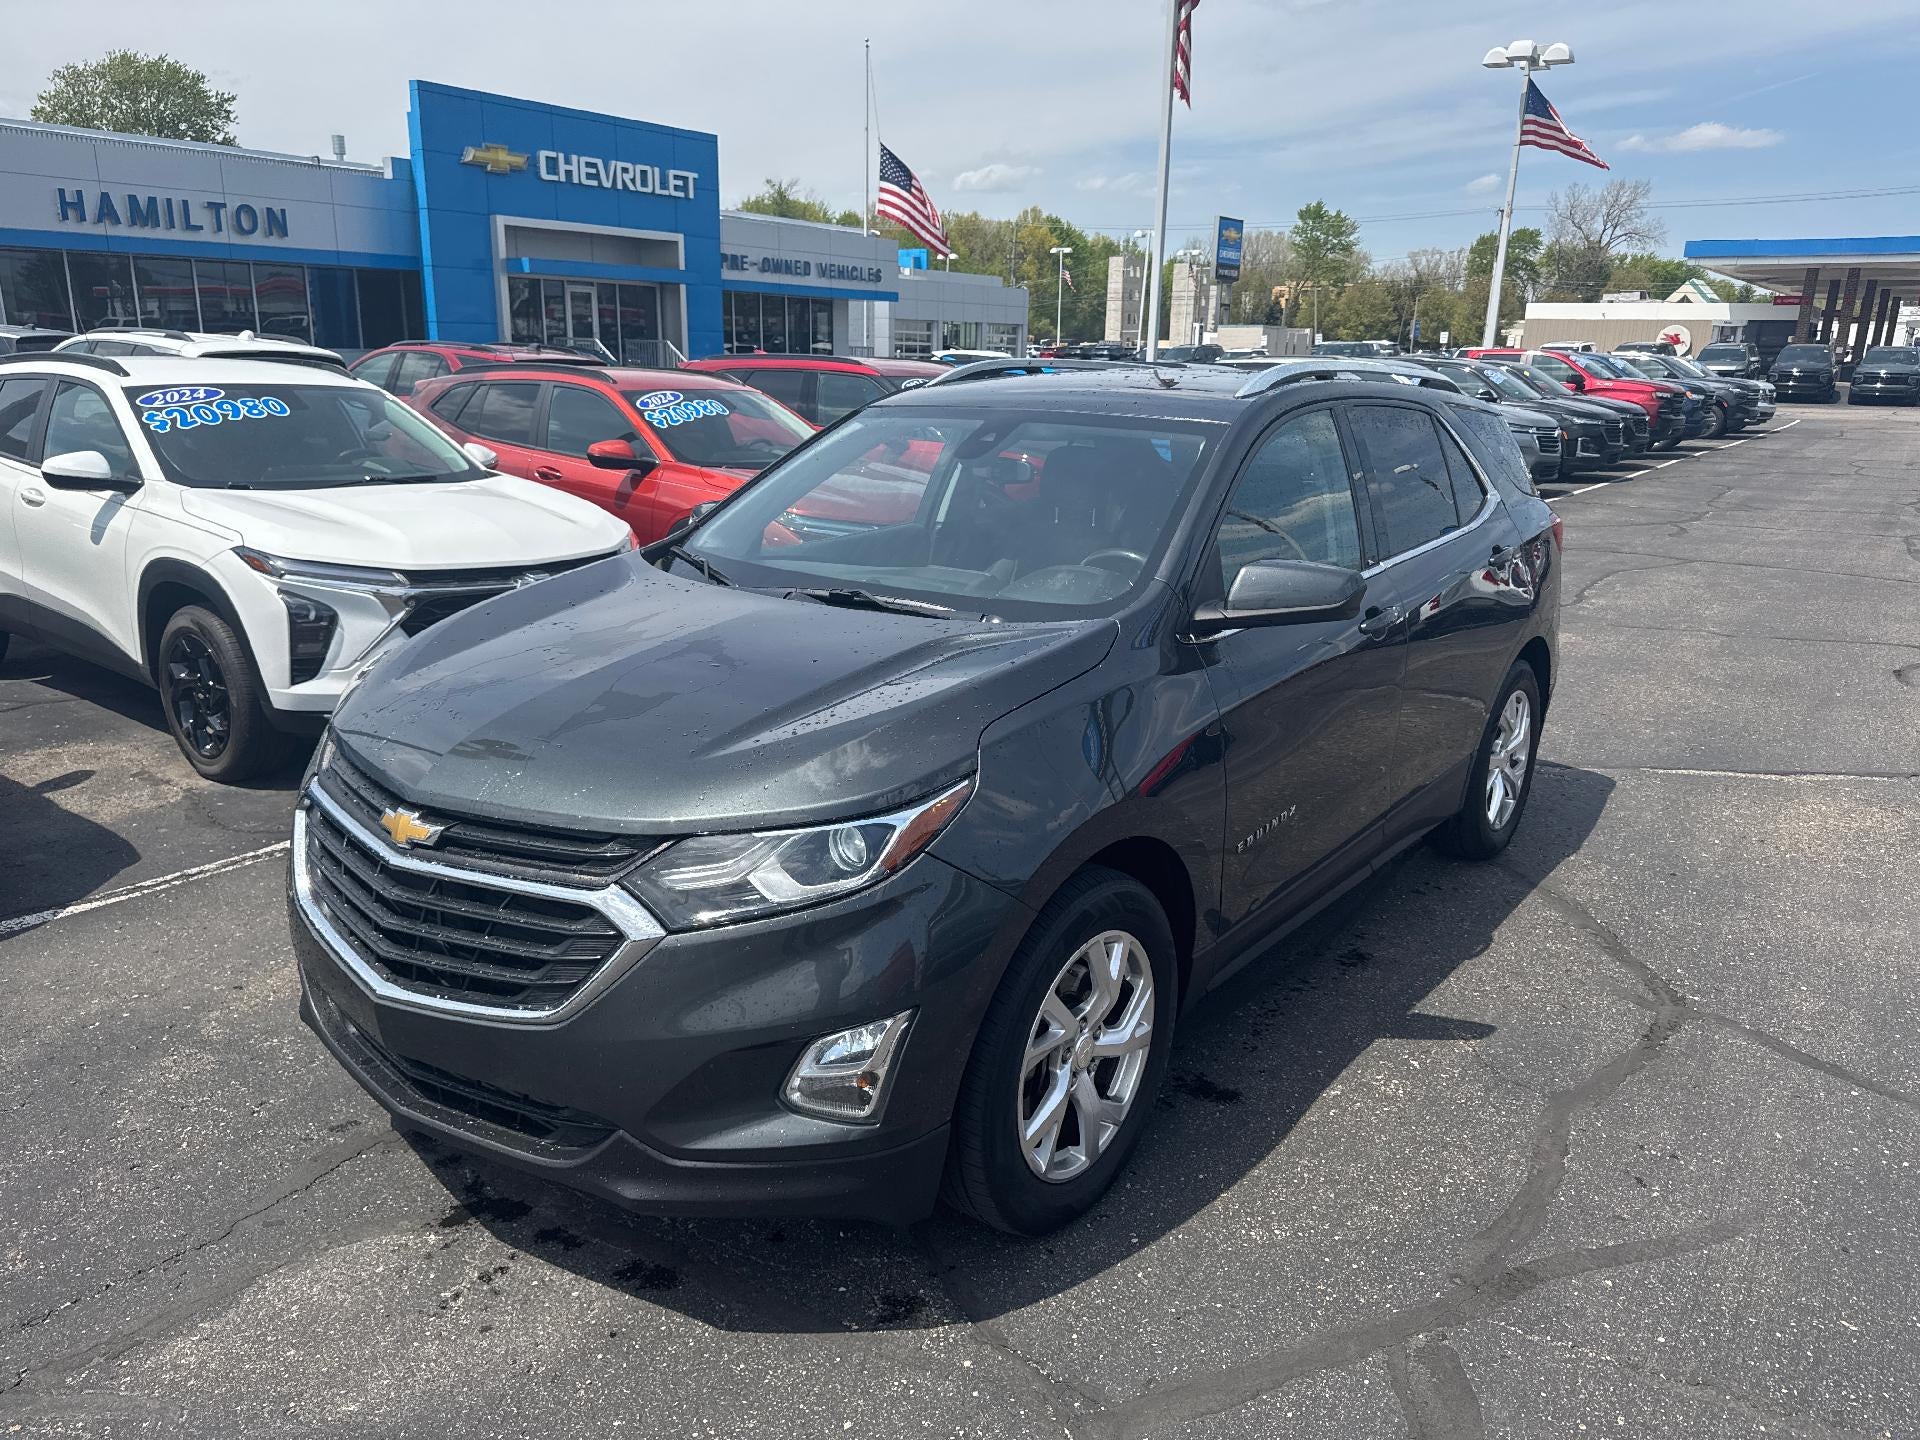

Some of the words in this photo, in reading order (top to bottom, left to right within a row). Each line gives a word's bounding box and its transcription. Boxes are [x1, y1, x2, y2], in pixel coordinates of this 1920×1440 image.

[538, 149, 699, 199] CHEVROLET
[56, 187, 289, 237] HAMILTON
[720, 252, 811, 277] PRE-OWNED
[816, 262, 883, 283] VEHICLES
[151, 388, 207, 406] 2024
[643, 391, 675, 409] 2024
[142, 397, 291, 433] $20980
[643, 399, 730, 429] $20980
[1236, 804, 1298, 854] EQUINOX
